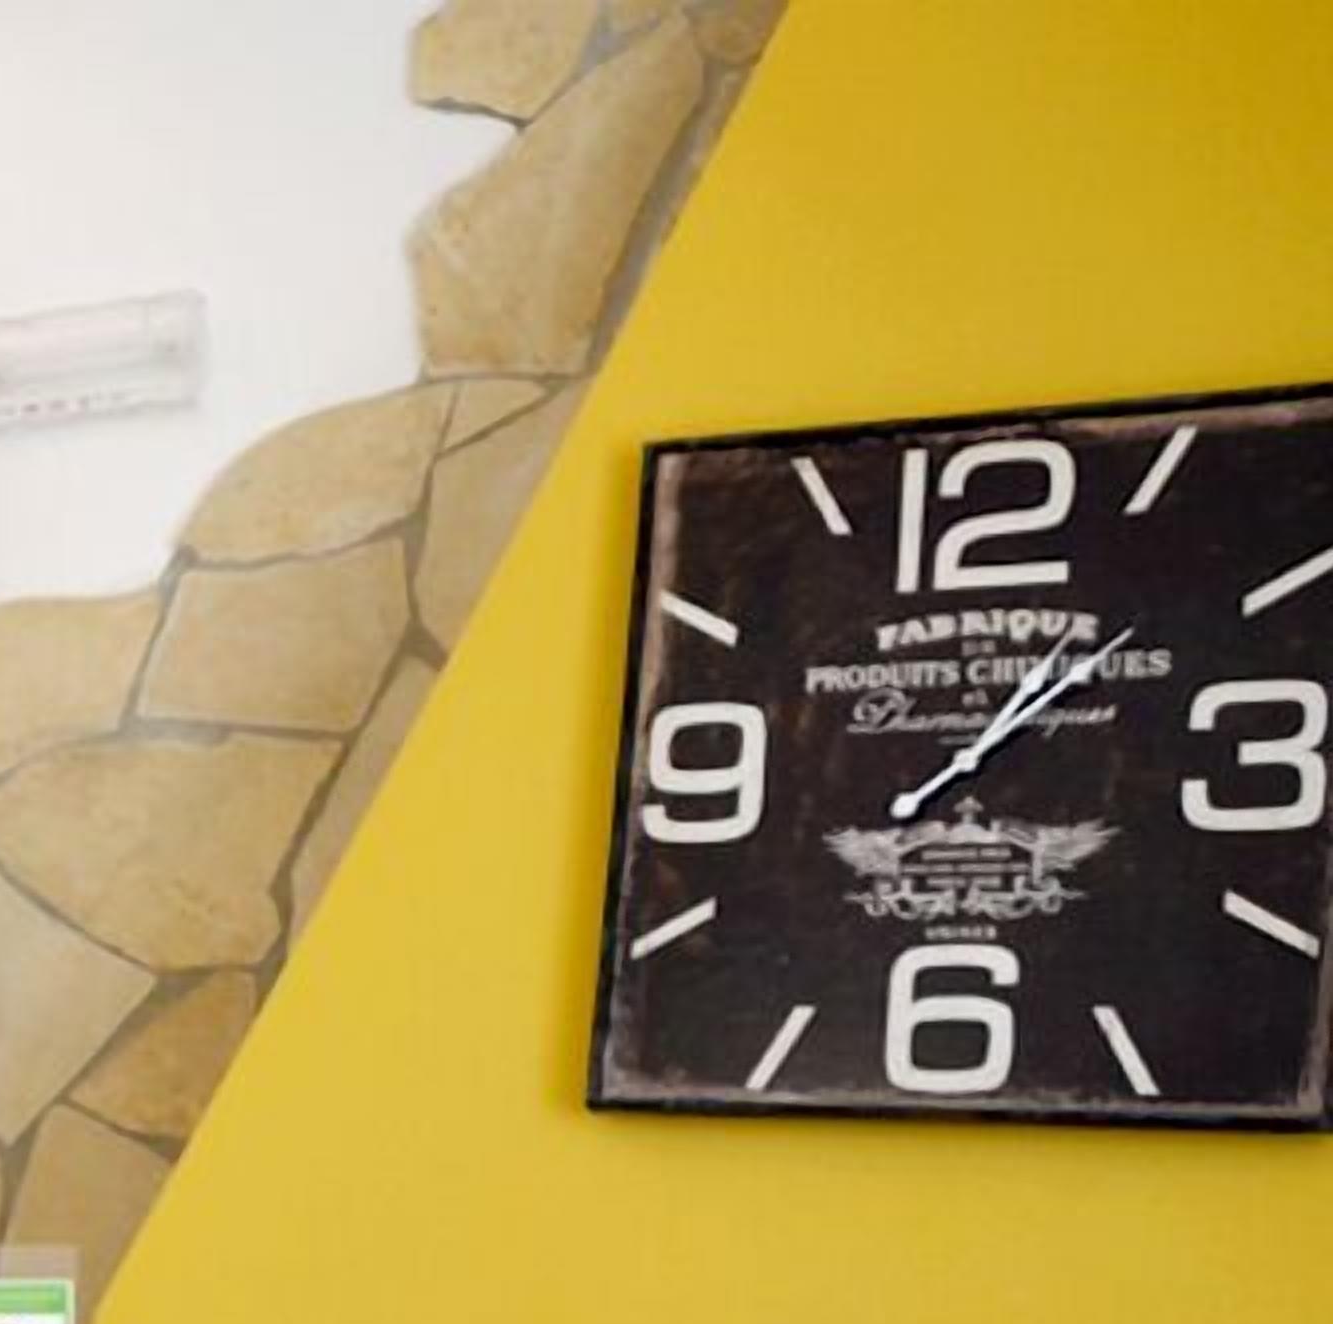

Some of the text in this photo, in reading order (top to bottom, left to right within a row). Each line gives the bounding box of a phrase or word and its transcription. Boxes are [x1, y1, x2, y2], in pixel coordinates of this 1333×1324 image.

[895, 439, 1077, 592] 12
[806, 660, 959, 693] PRODUITS
[876, 609, 1098, 650] FABRIQUE
[642, 702, 767, 844] 9
[1181, 678, 1328, 831] 3
[886, 944, 1020, 1092] 6
